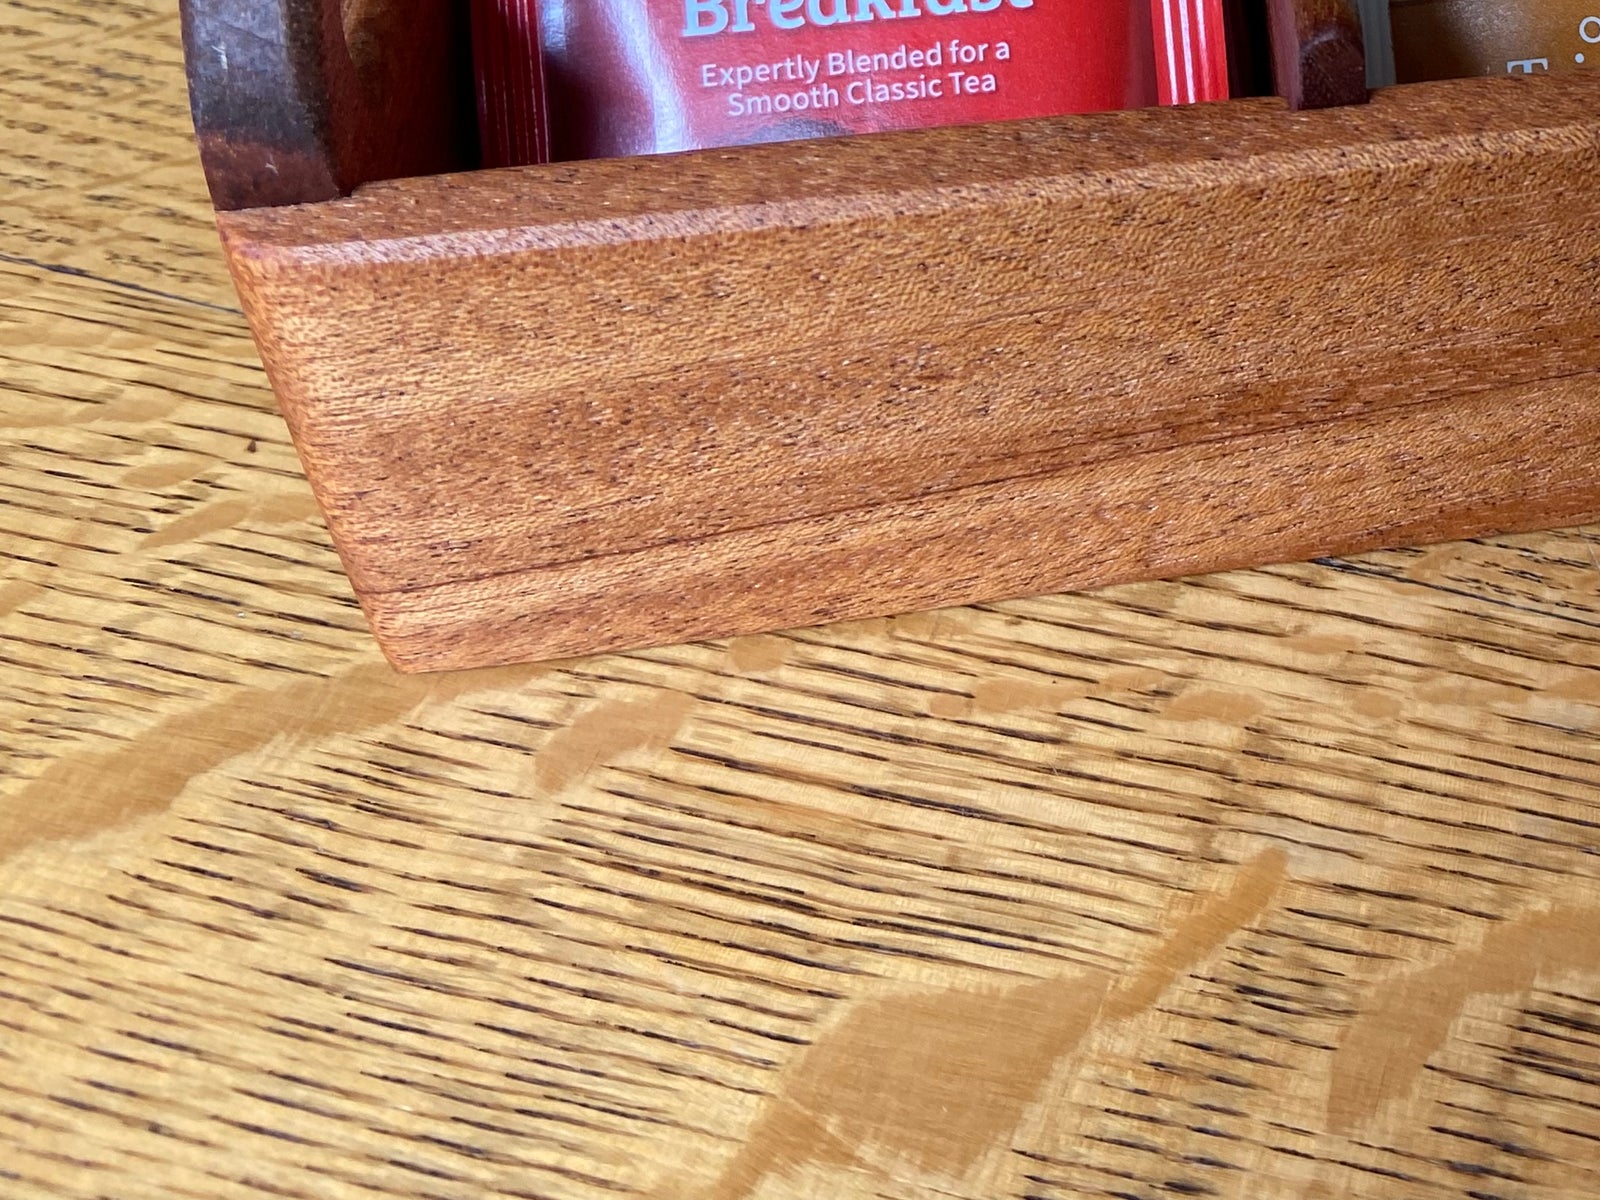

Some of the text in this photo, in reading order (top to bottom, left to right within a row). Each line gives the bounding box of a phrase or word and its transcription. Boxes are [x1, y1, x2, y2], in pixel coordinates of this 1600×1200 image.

[702, 39, 1010, 90] Expertly Blended for a
[727, 71, 997, 117] Smooth Classic Tea
